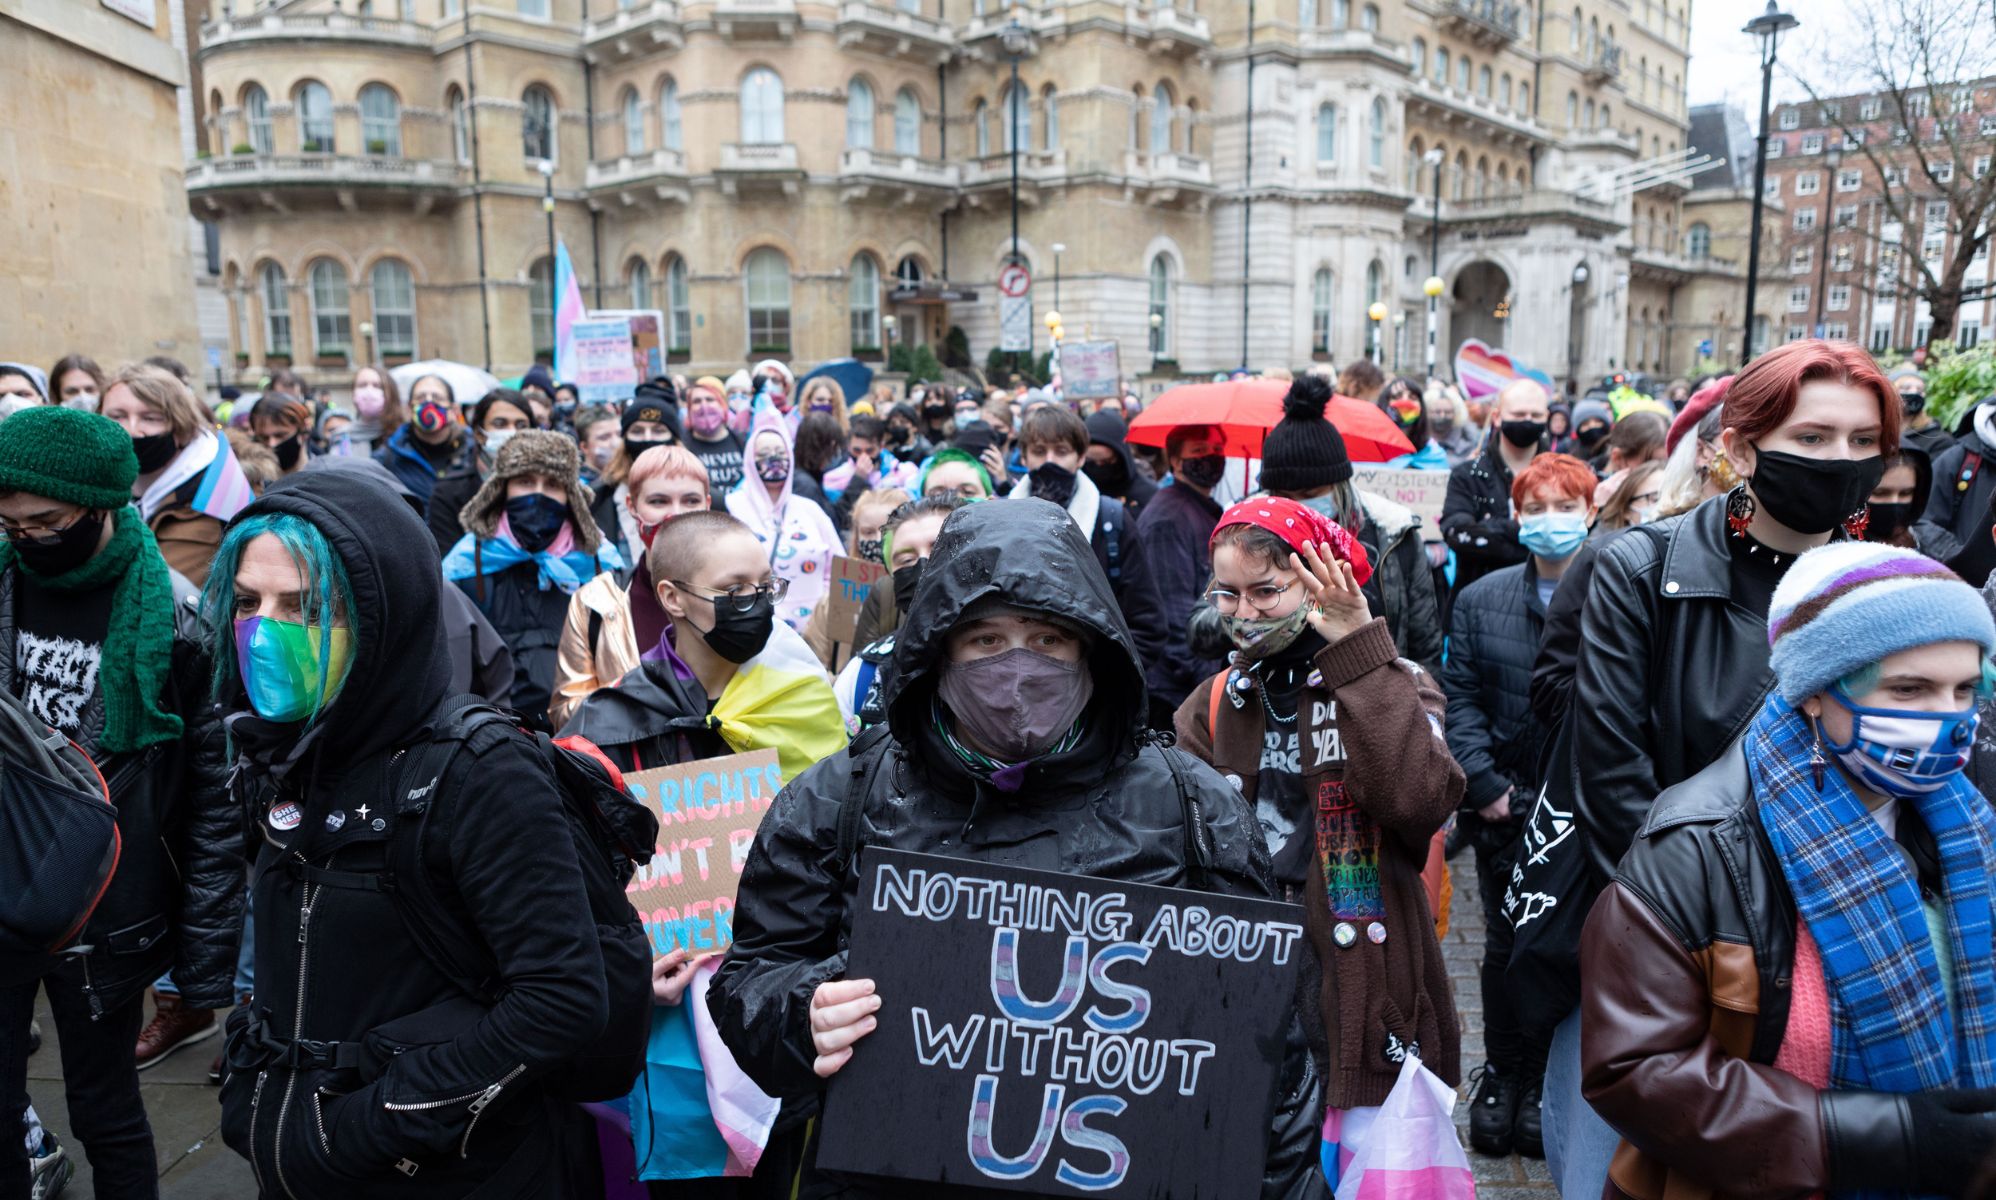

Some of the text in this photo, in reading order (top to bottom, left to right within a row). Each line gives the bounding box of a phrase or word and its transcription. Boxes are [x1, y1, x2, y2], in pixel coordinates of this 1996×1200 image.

[1355, 471, 1377, 484] MY
[1396, 488, 1425, 503] NOT
[858, 563, 888, 583] ST
[274, 804, 297, 819] SHE
[279, 811, 301, 825] HER
[1328, 849, 1374, 865] NOT
[1328, 866, 1379, 885] RAINBO
[872, 863, 1304, 966] NOTHING ABOUT
[638, 896, 737, 956] OVER
[990, 926, 1152, 1034] US
[911, 1006, 1216, 1096] WITHOUT
[967, 1073, 1131, 1192] US
